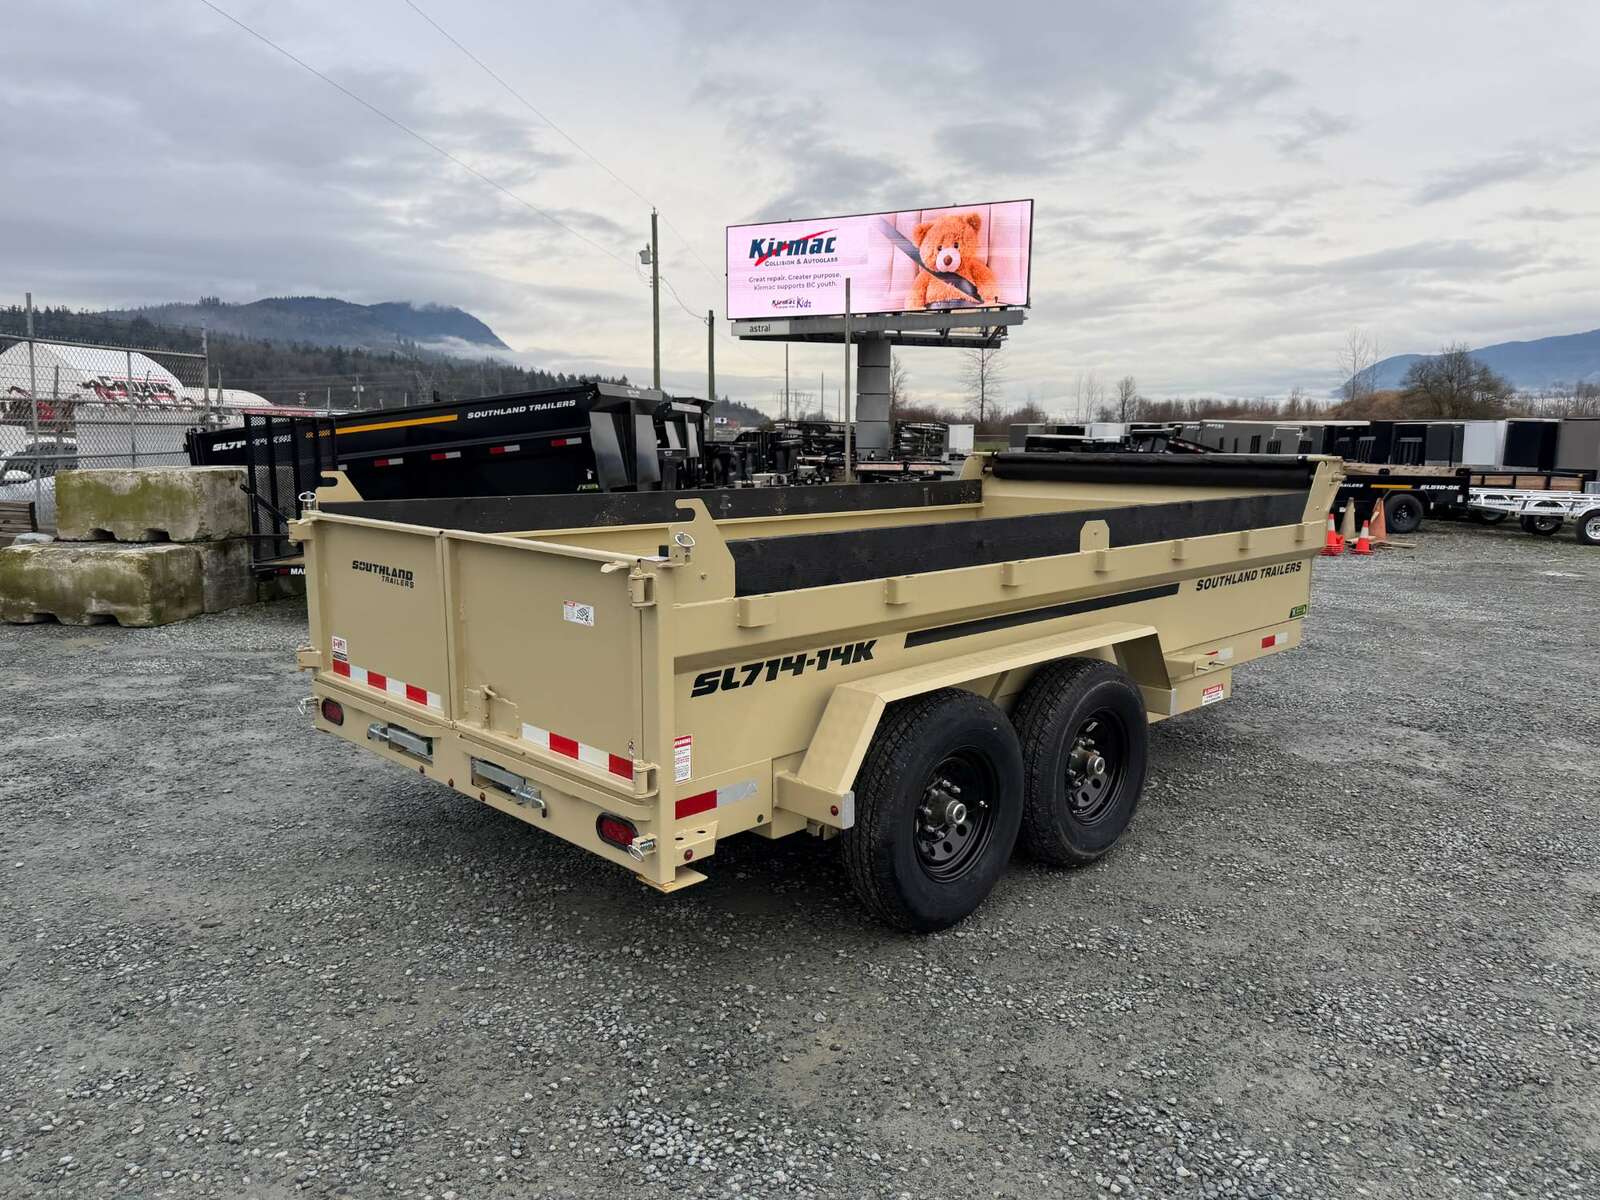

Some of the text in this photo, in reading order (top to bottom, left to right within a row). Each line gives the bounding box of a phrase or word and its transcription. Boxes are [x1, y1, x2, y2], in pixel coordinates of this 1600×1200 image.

[749, 237, 837, 259] Kirmac
[777, 282, 805, 290] supports
[749, 323, 771, 333] astral
[467, 400, 576, 419] SOUTHLAND TRAILERS
[352, 560, 414, 581] SOUTHLAND
[1195, 561, 1303, 591] SOUTHLAND TRAILERS
[381, 575, 415, 589] TRAILERS
[690, 639, 878, 698] SL714-14K
